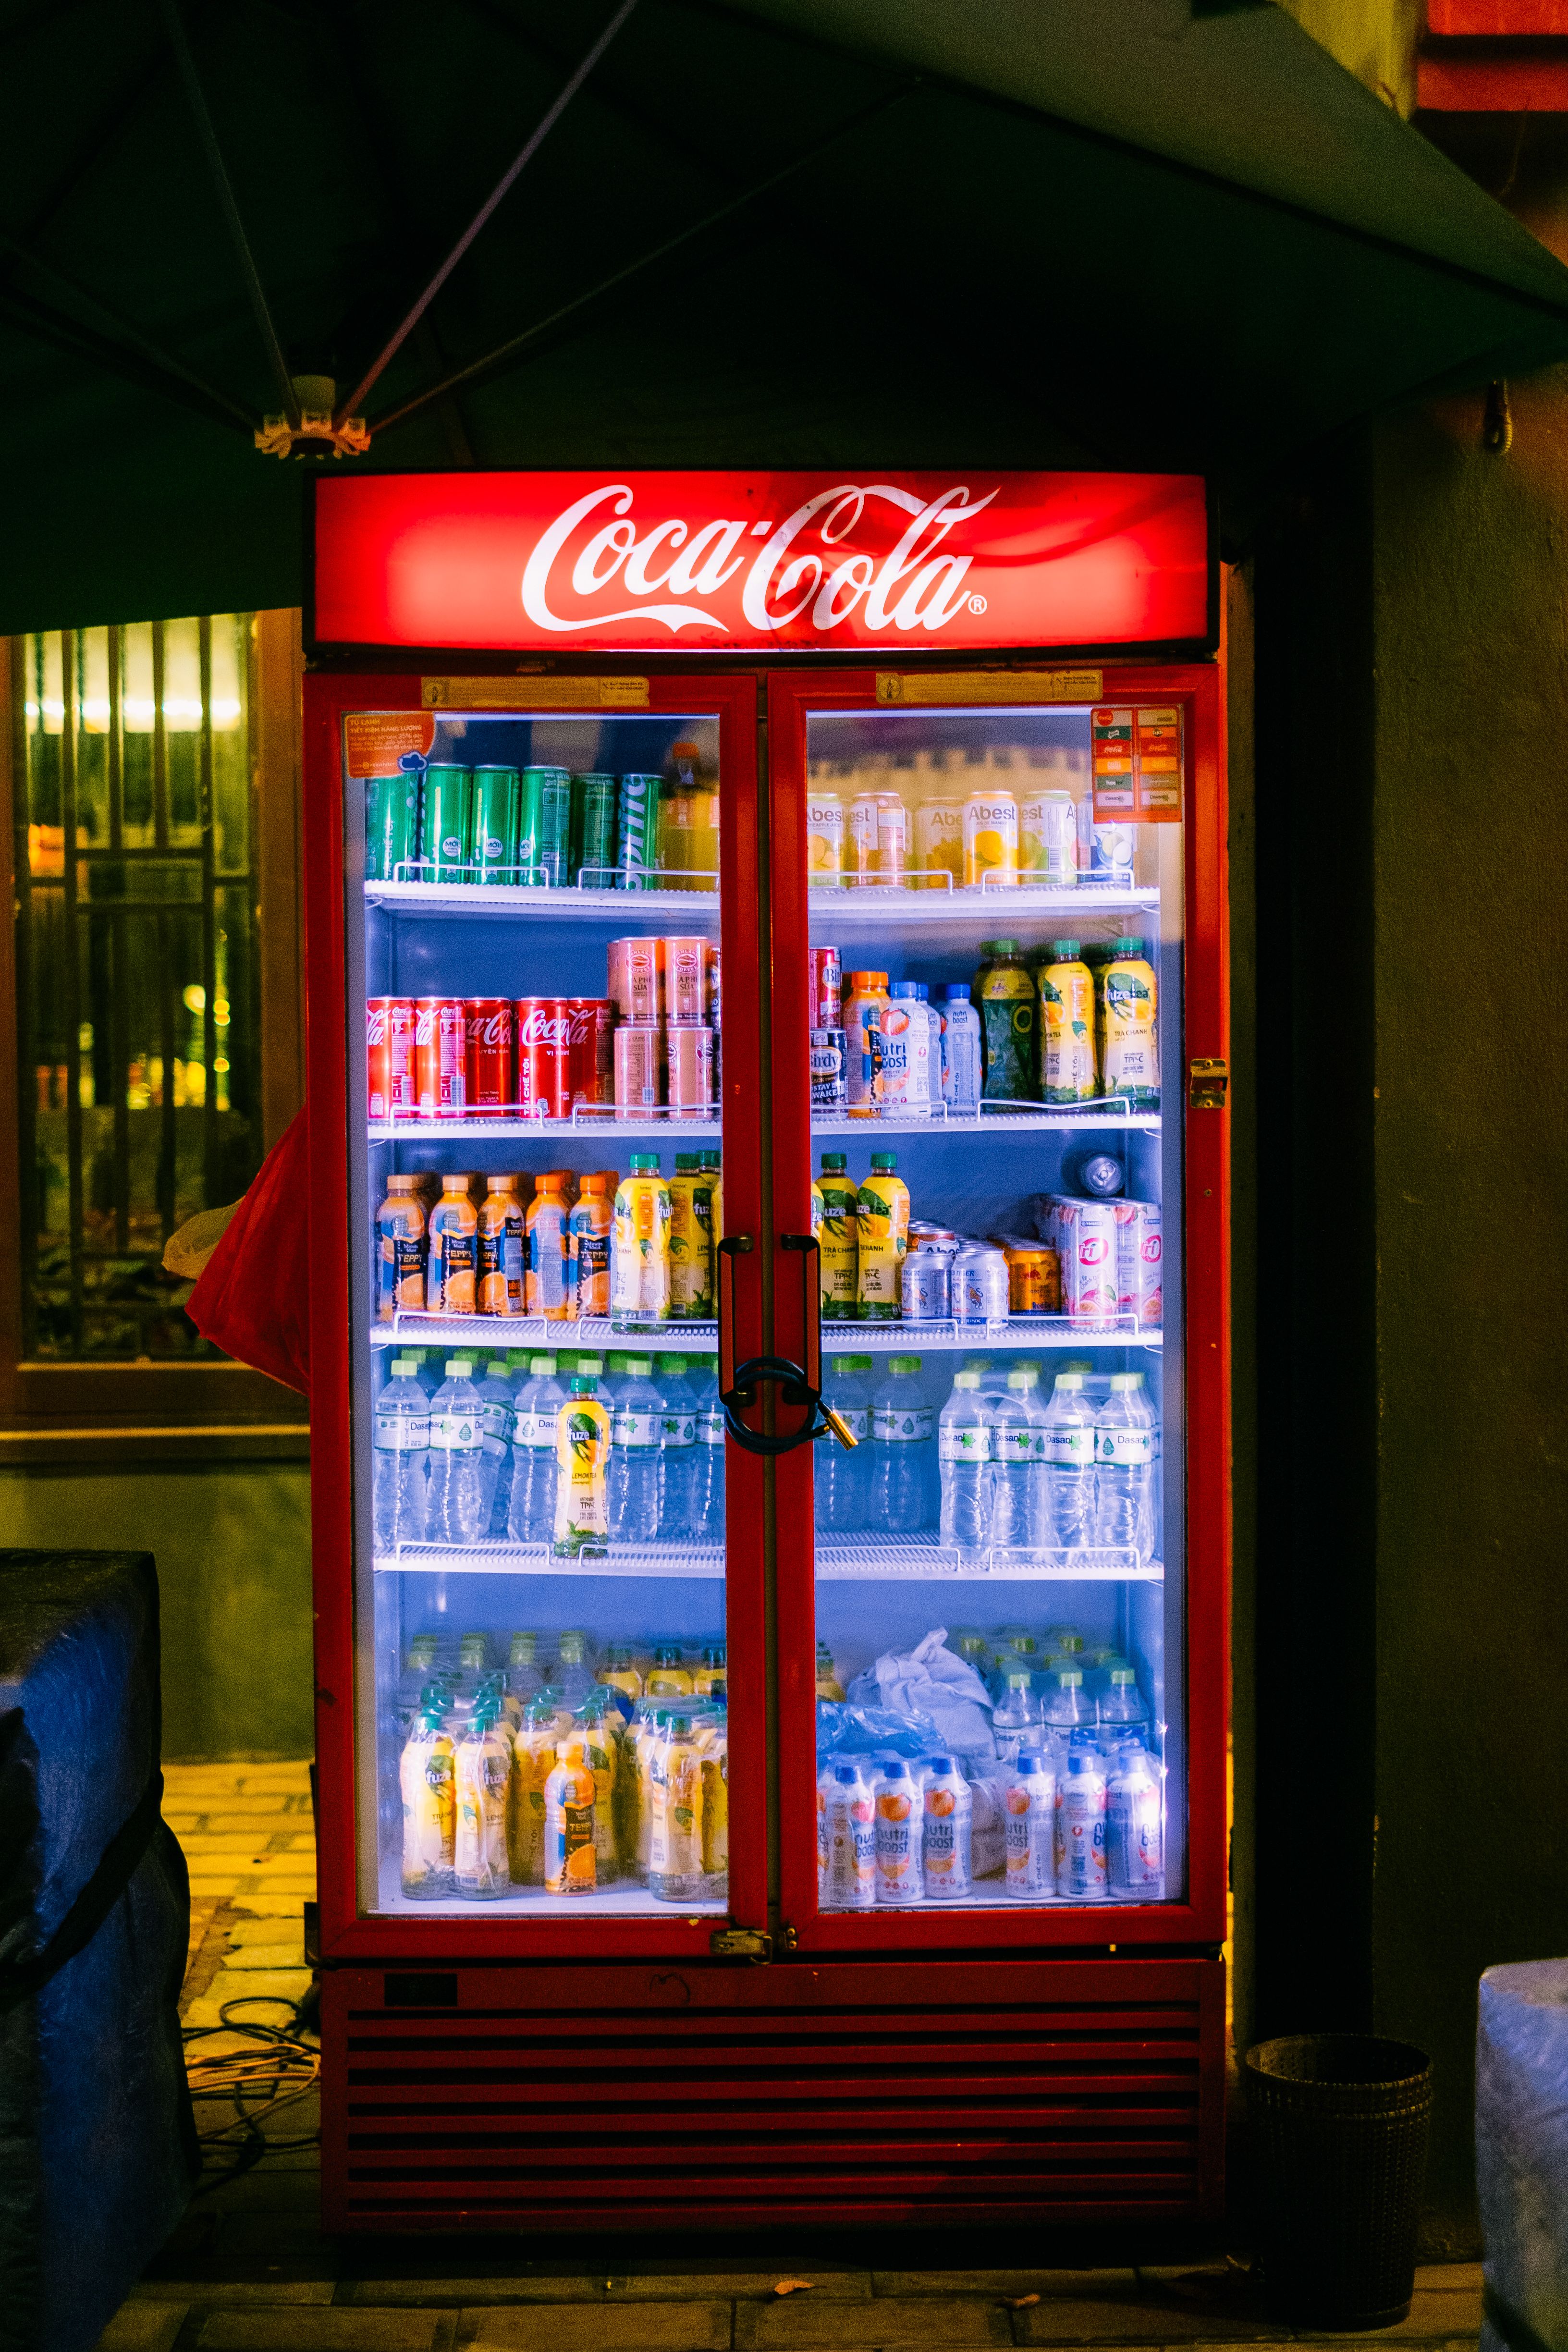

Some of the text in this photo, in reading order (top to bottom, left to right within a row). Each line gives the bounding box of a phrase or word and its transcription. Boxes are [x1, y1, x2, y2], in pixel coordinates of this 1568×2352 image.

[521, 484, 1002, 633] Coca-Cola
[850, 807, 870, 822] est
[968, 806, 1015, 821] Abest
[1022, 805, 1043, 820] est
[826, 968, 840, 982] Bir
[882, 1042, 906, 1056] utri
[810, 1052, 838, 1068] irdy
[882, 1054, 907, 1068] oost
[812, 1089, 837, 1099] WAKE
[411, 1421, 429, 1430] Dasa
[1118, 1435, 1145, 1444] Dasan
[1008, 1822, 1027, 1834] utri
[1008, 1835, 1028, 1848] oost
